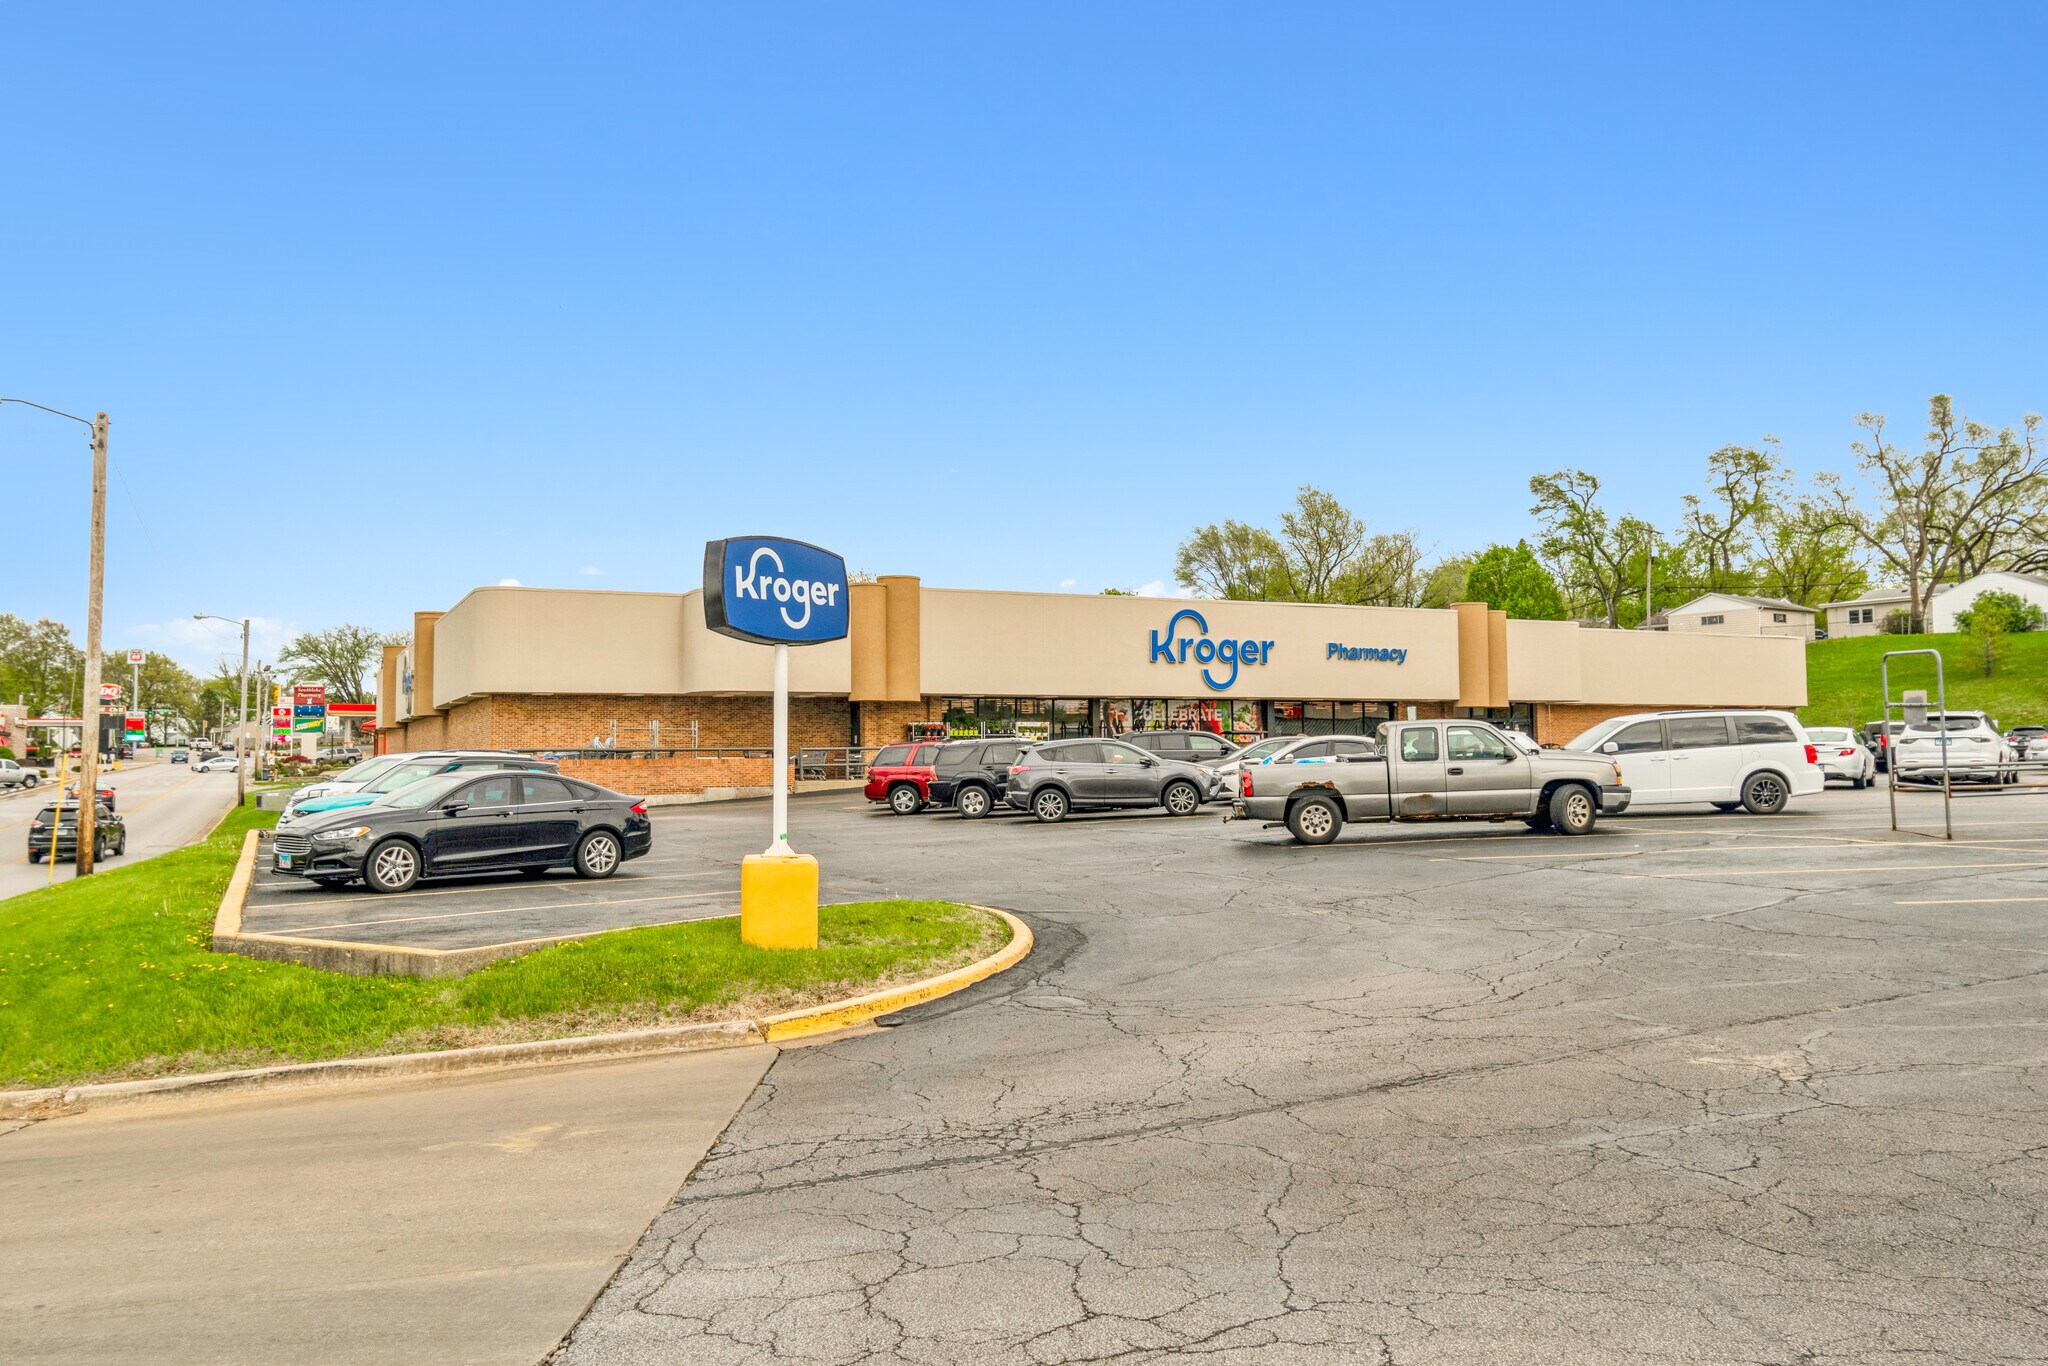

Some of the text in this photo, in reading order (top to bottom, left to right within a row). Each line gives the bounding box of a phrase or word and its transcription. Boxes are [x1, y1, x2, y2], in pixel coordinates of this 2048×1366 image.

[735, 547, 839, 630] Kroger
[1150, 608, 1275, 691] Kroger
[1326, 642, 1408, 665] Pharmacy
[100, 687, 117, 696] DQ
[1143, 708, 1222, 721] CELEBRATE
[296, 720, 323, 731] SUBWAY
